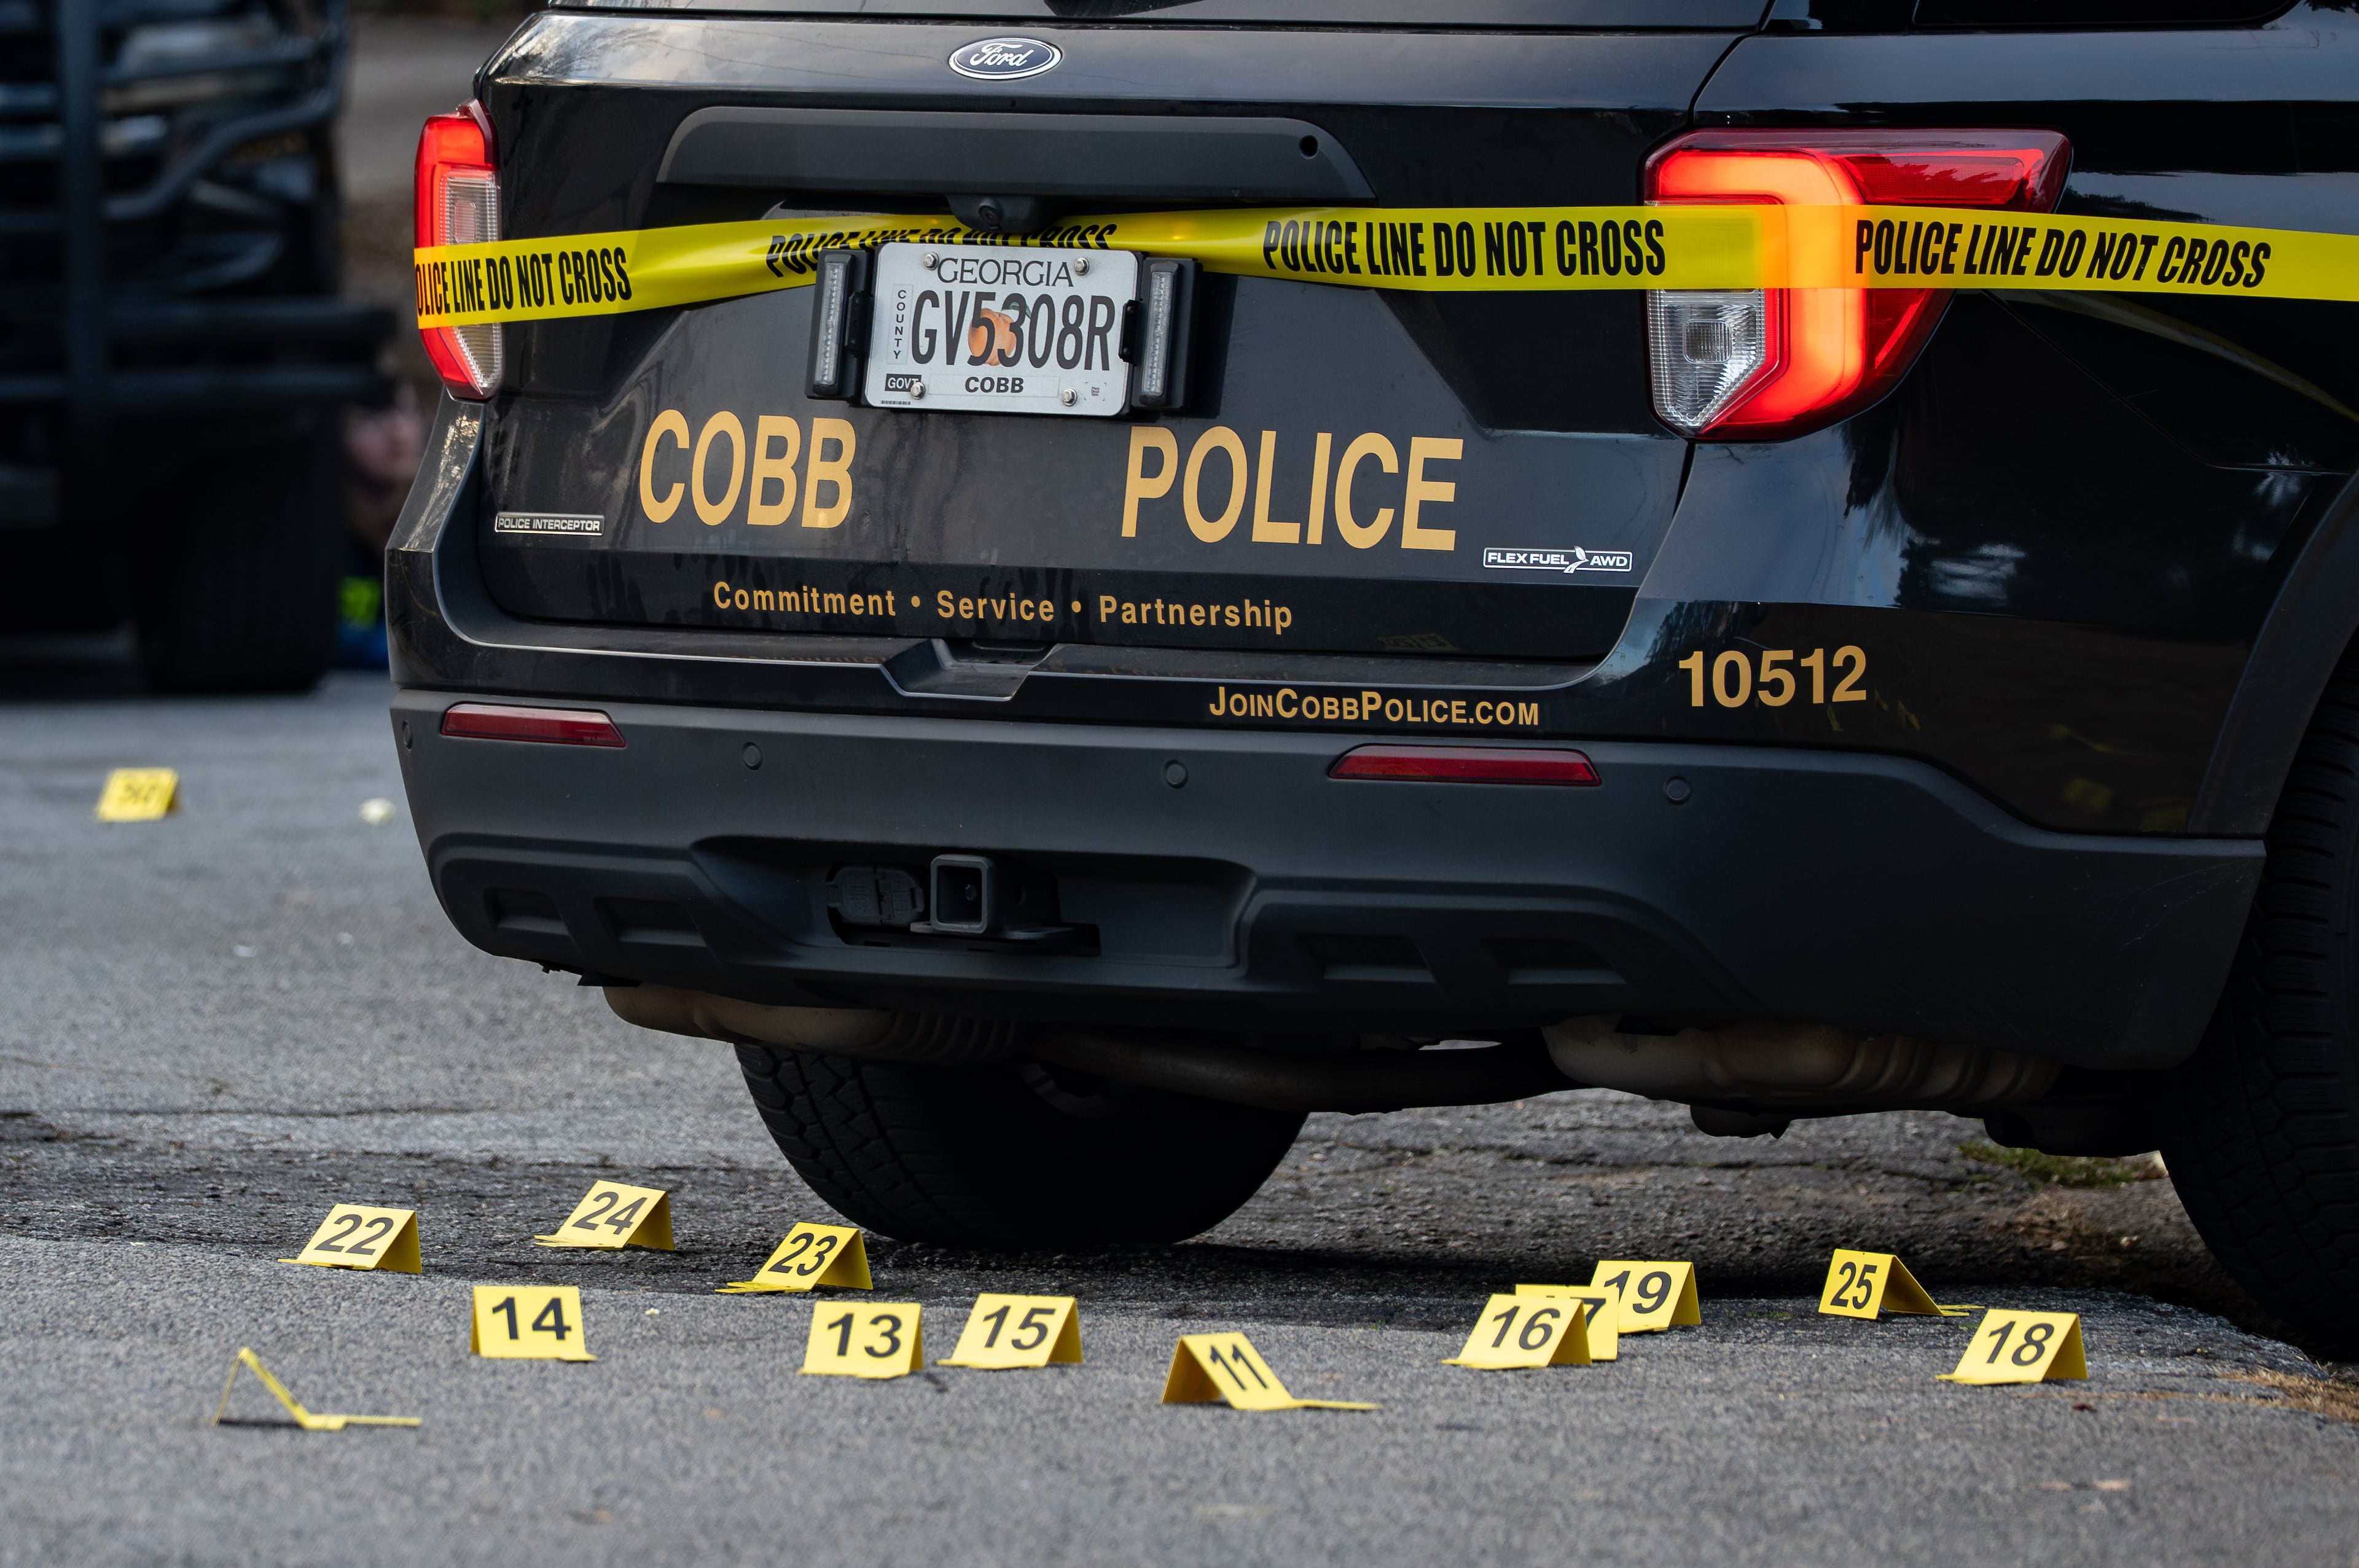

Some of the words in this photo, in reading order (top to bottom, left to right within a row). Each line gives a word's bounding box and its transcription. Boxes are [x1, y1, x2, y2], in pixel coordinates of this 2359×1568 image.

[970, 42, 1035, 67] Ford
[1262, 220, 1363, 276] POLICE
[1365, 221, 1428, 277] LINE
[1433, 220, 1476, 278] DO
[1484, 220, 1547, 277] NOT
[1555, 219, 1666, 276] CROSS
[1855, 219, 1963, 275] POLICE
[1963, 224, 2037, 276] LINE
[2034, 228, 2087, 278] DO
[2085, 232, 2160, 281] NOT
[2156, 235, 2272, 288] CROSS
[415, 262, 451, 318] OLICE
[450, 259, 485, 314] LINE
[485, 255, 514, 311] DO
[515, 252, 555, 308] NOT
[558, 246, 633, 305] CROSS
[937, 257, 1074, 287] GEORGIA
[893, 289, 907, 360] COUNTY
[912, 290, 1116, 371] GV5308R
[965, 376, 1024, 393] COBB
[639, 409, 856, 529] COBB
[1121, 426, 1465, 552] POLICE
[498, 517, 531, 529] POLICE
[532, 518, 601, 531] INTERCEPTOR
[1487, 552, 1528, 564] FLEX
[1529, 553, 1570, 564] FUEL
[1589, 555, 1628, 567] AWD
[714, 581, 896, 616] Commitment
[937, 590, 1054, 622] Service
[1100, 595, 1292, 635] Partnership
[1679, 645, 1867, 708] 10512
[314, 1214, 394, 1255] 22
[572, 1192, 647, 1235] 24
[768, 1232, 838, 1276] 23
[1603, 1270, 1672, 1314] 19
[1829, 1262, 1877, 1310] 25
[492, 1297, 572, 1341] 14
[827, 1313, 902, 1359] 13
[983, 1305, 1056, 1351] 15
[1492, 1305, 1561, 1351] 16
[1985, 1320, 2055, 1367] 18
[1210, 1343, 1269, 1392] 11
